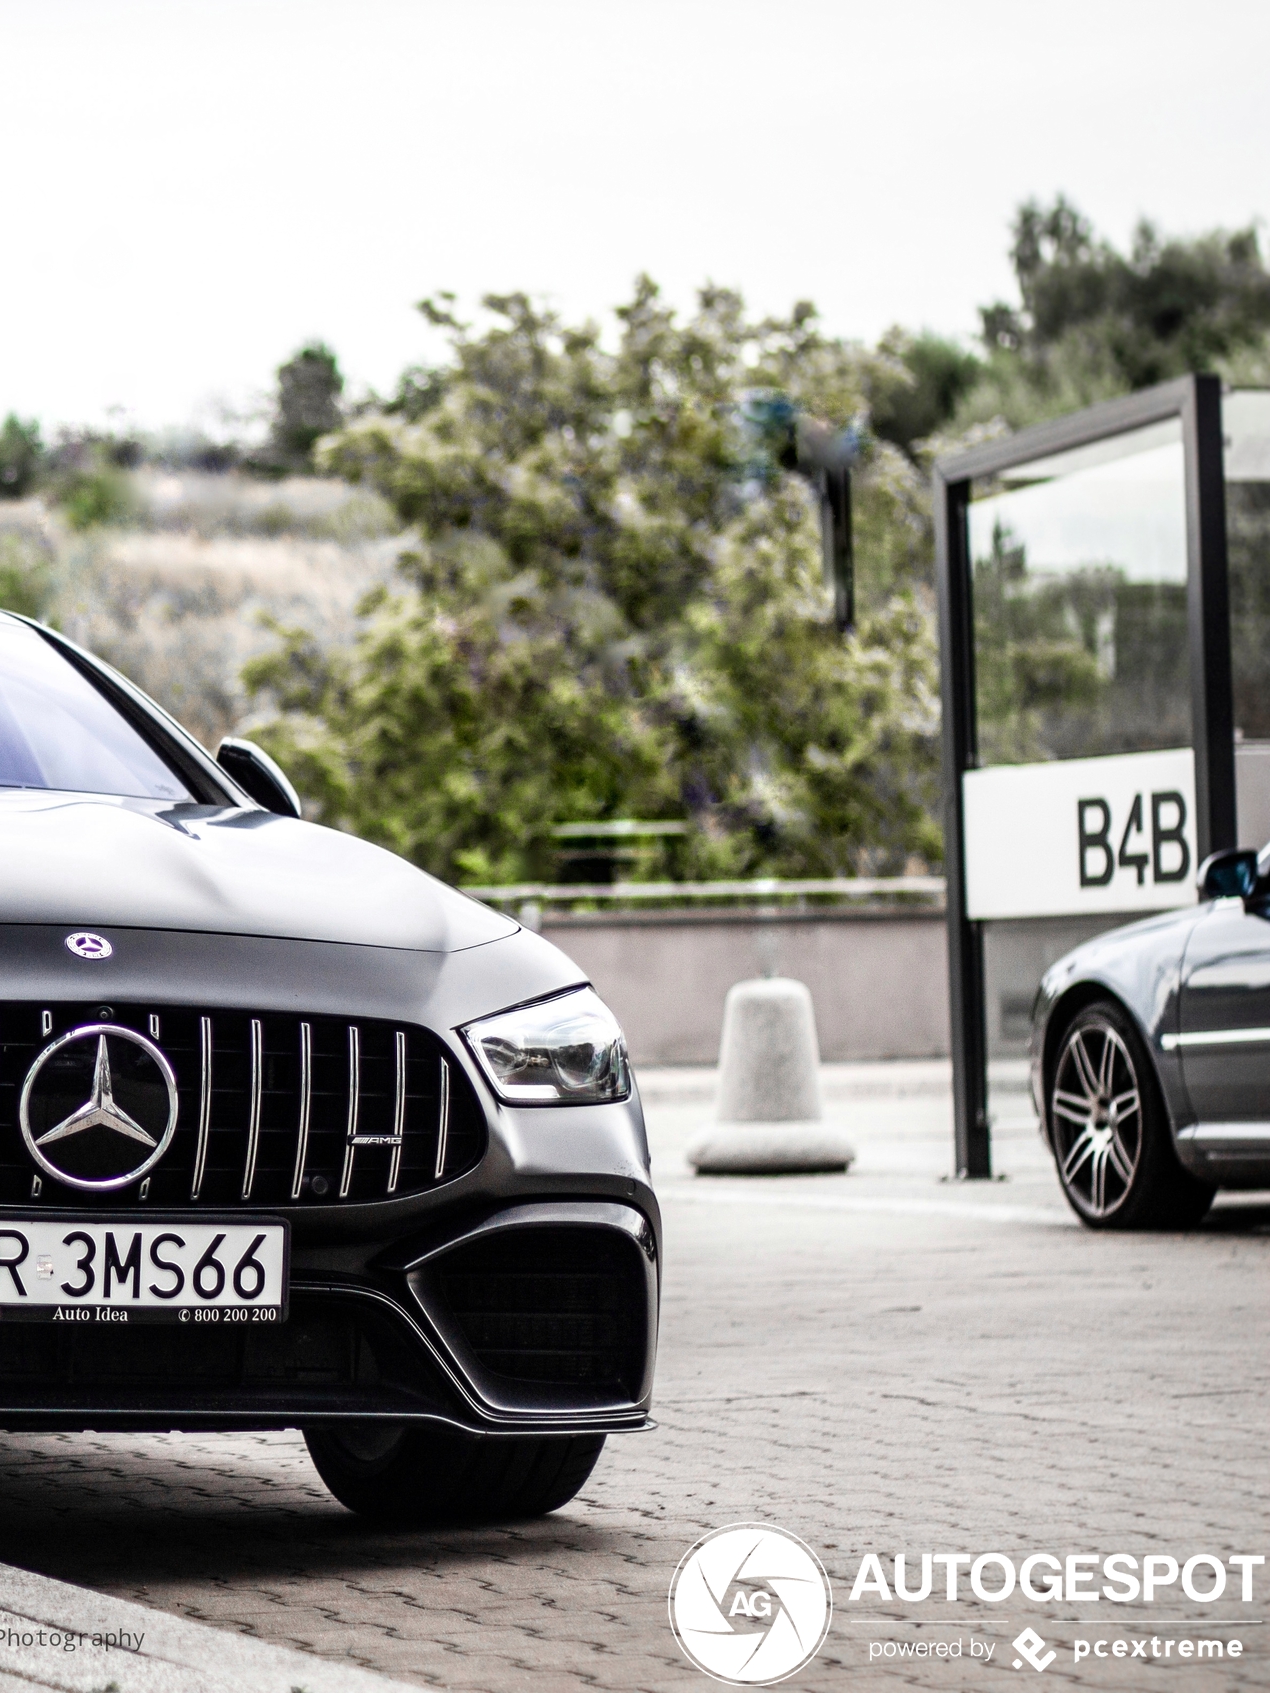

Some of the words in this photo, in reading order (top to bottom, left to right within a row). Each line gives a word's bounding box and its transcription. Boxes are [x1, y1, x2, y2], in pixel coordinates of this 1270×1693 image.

[1077, 789, 1190, 888] B4B
[60, 1230, 267, 1300] 3MS66
[52, 1306, 90, 1321] Auto
[95, 1306, 128, 1322] Idea
[194, 1308, 219, 1322] 800
[223, 1308, 248, 1322] 200
[252, 1308, 276, 1321] 200
